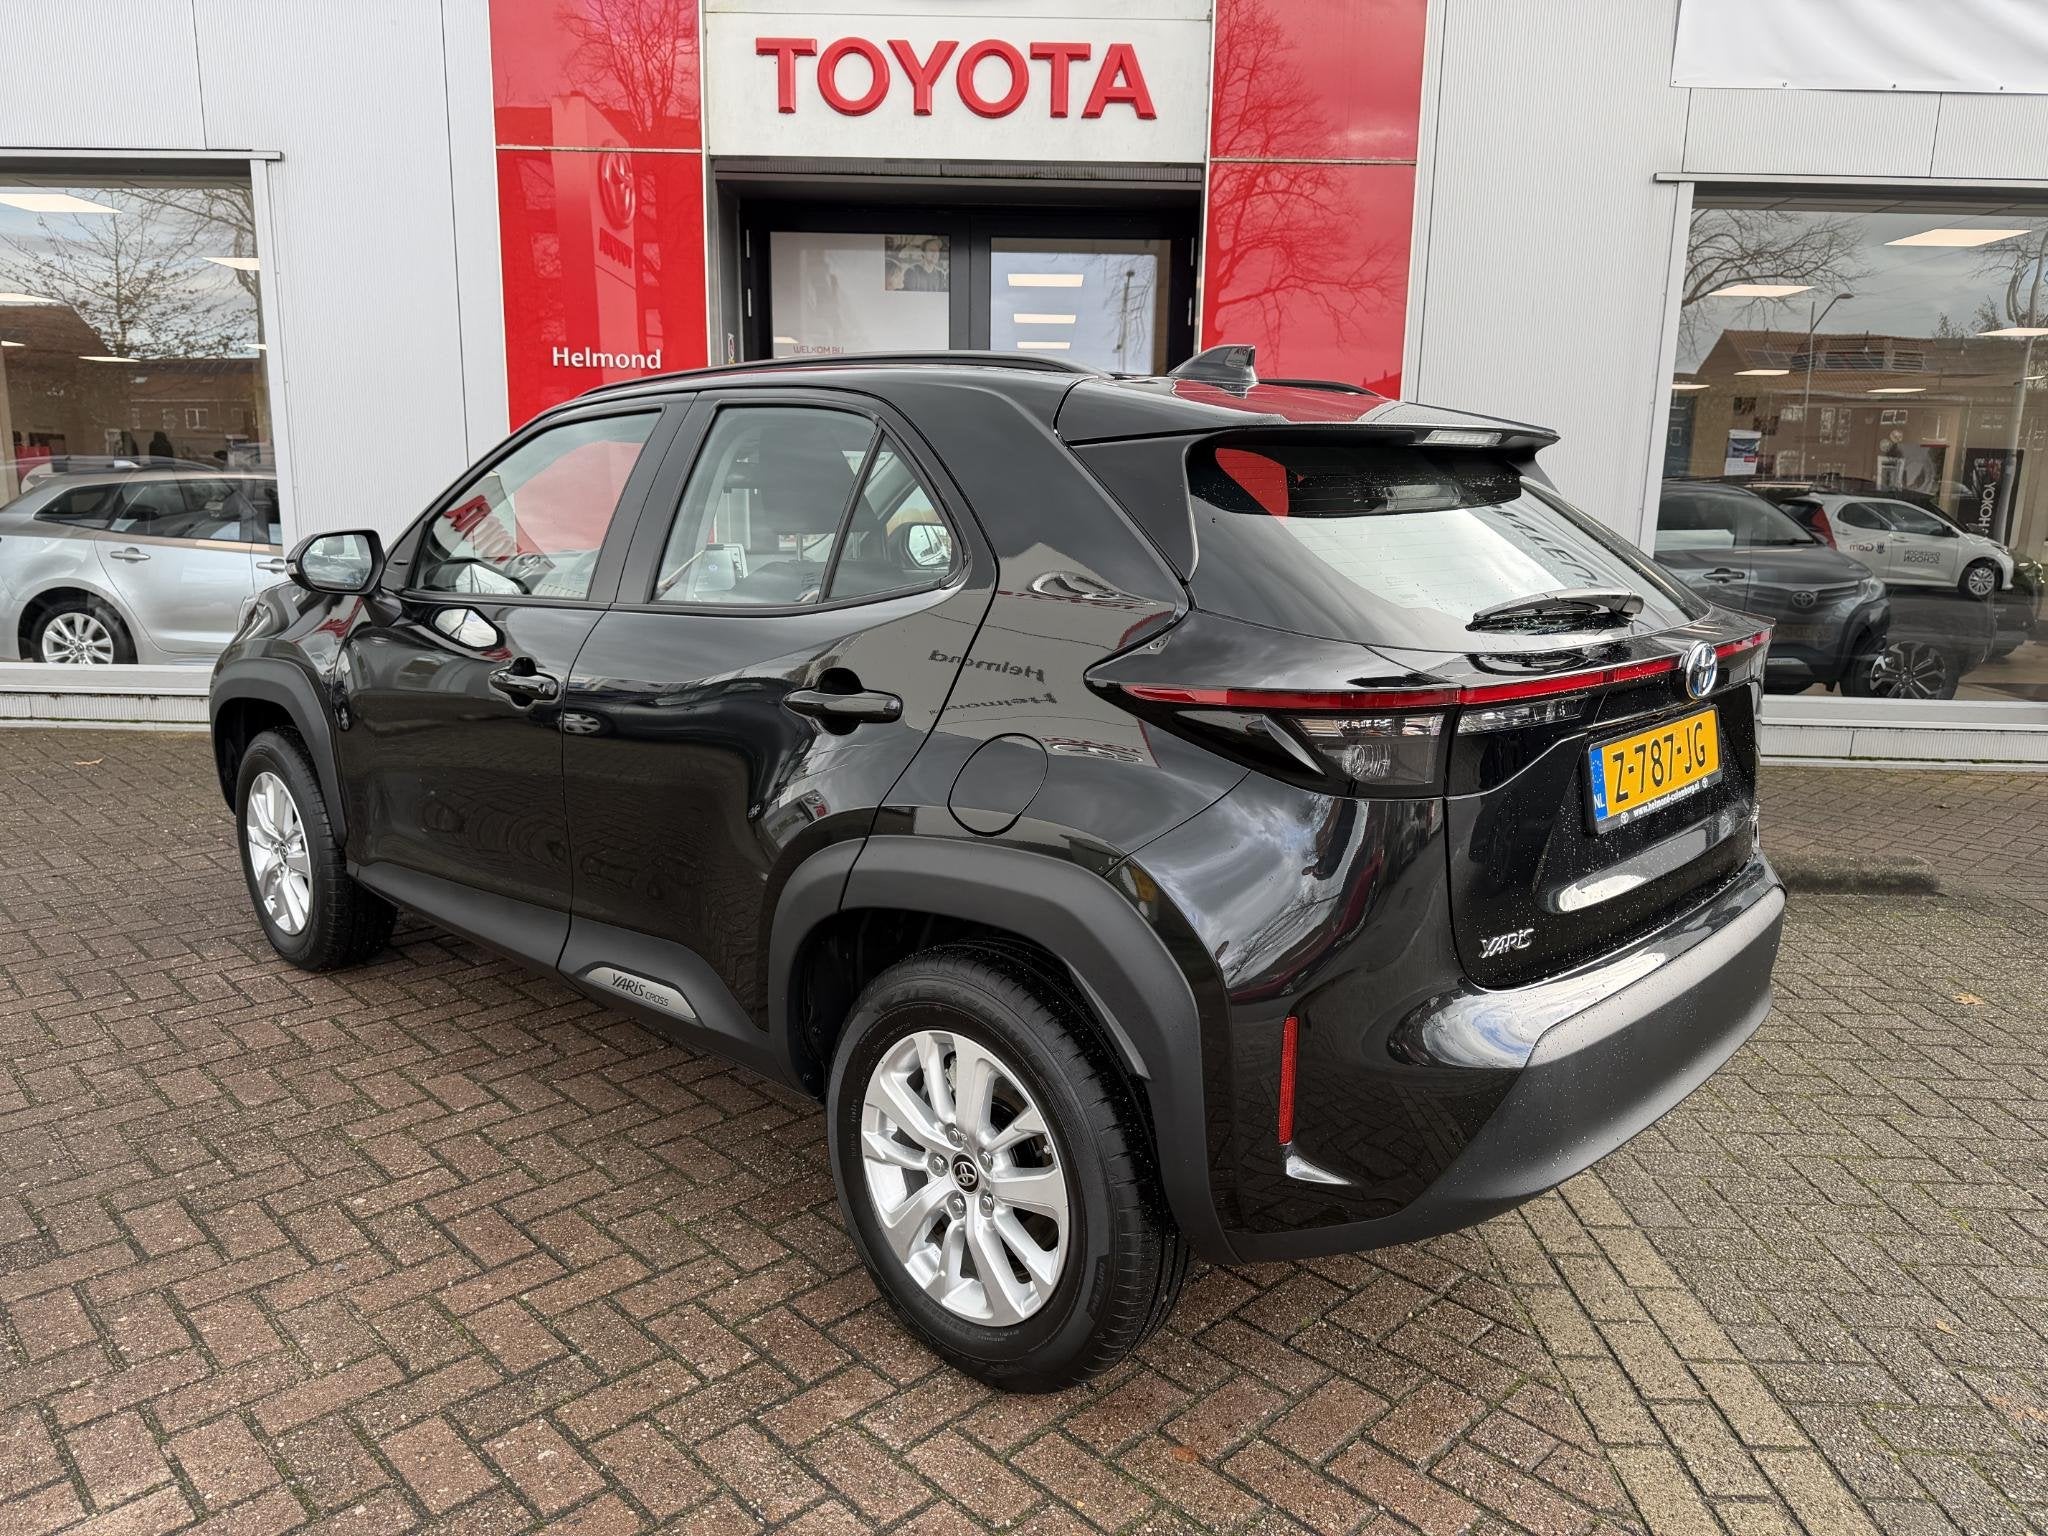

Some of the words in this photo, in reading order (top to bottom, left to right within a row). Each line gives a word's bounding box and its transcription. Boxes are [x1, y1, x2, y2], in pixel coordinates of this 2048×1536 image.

[755, 36, 1157, 120] TOYOTA
[551, 346, 662, 370] Helmond
[793, 345, 831, 354] WELKOM
[1593, 793, 1606, 811] NL
[1612, 721, 1706, 804] Z-787-JG
[645, 991, 669, 1007] CROSS
